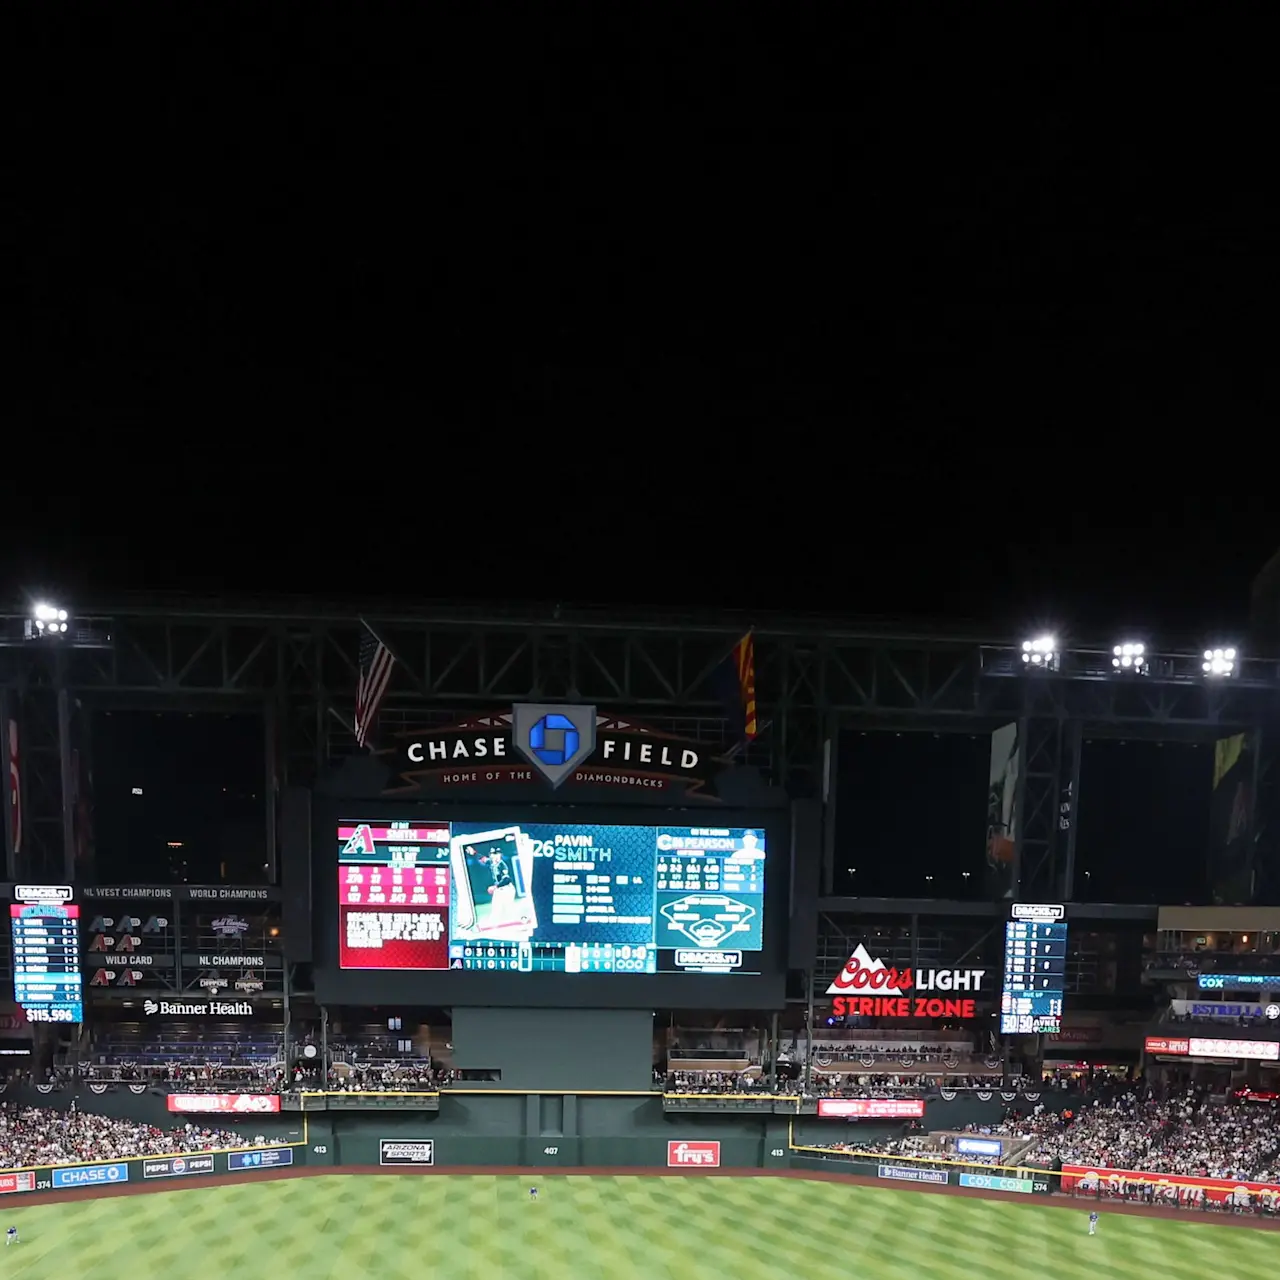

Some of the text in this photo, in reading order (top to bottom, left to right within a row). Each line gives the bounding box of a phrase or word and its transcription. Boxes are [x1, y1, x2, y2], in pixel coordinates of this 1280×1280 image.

[407, 737, 699, 769] CHASE FIELD
[443, 771, 664, 787] HOME OF THE DIAMONDBACKS
[555, 834, 593, 847] PAVIN
[685, 838, 735, 849] PEARSON
[533, 840, 554, 857] 26
[555, 847, 611, 861] SMITH
[84, 889, 171, 897] NL WEST CHAMPIONS
[190, 890, 268, 898] WORLD CHAMPIONS
[106, 956, 153, 965] WILD CARD
[199, 956, 264, 965] NL CHAMPIONS
[834, 957, 985, 990] Coors LIGHT
[1200, 978, 1224, 988] COX
[161, 1002, 253, 1015] Banner Health
[833, 997, 976, 1018] STRIKE ZONE
[1192, 1004, 1262, 1018] ESTRELLA
[26, 1009, 73, 1022] $115,596
[313, 1145, 327, 1154] 413
[544, 1147, 558, 1155] 407
[673, 1143, 715, 1164] fry's
[770, 1149, 784, 1157] 413
[146, 1164, 168, 1173] PEPSI
[190, 1160, 211, 1169] PEPSI
[61, 1170, 106, 1183] CHASE
[891, 1169, 943, 1182] Banner Health
[36, 1180, 51, 1190] 374
[969, 1176, 1024, 1190] COX COX
[1033, 1182, 1048, 1192] 374
